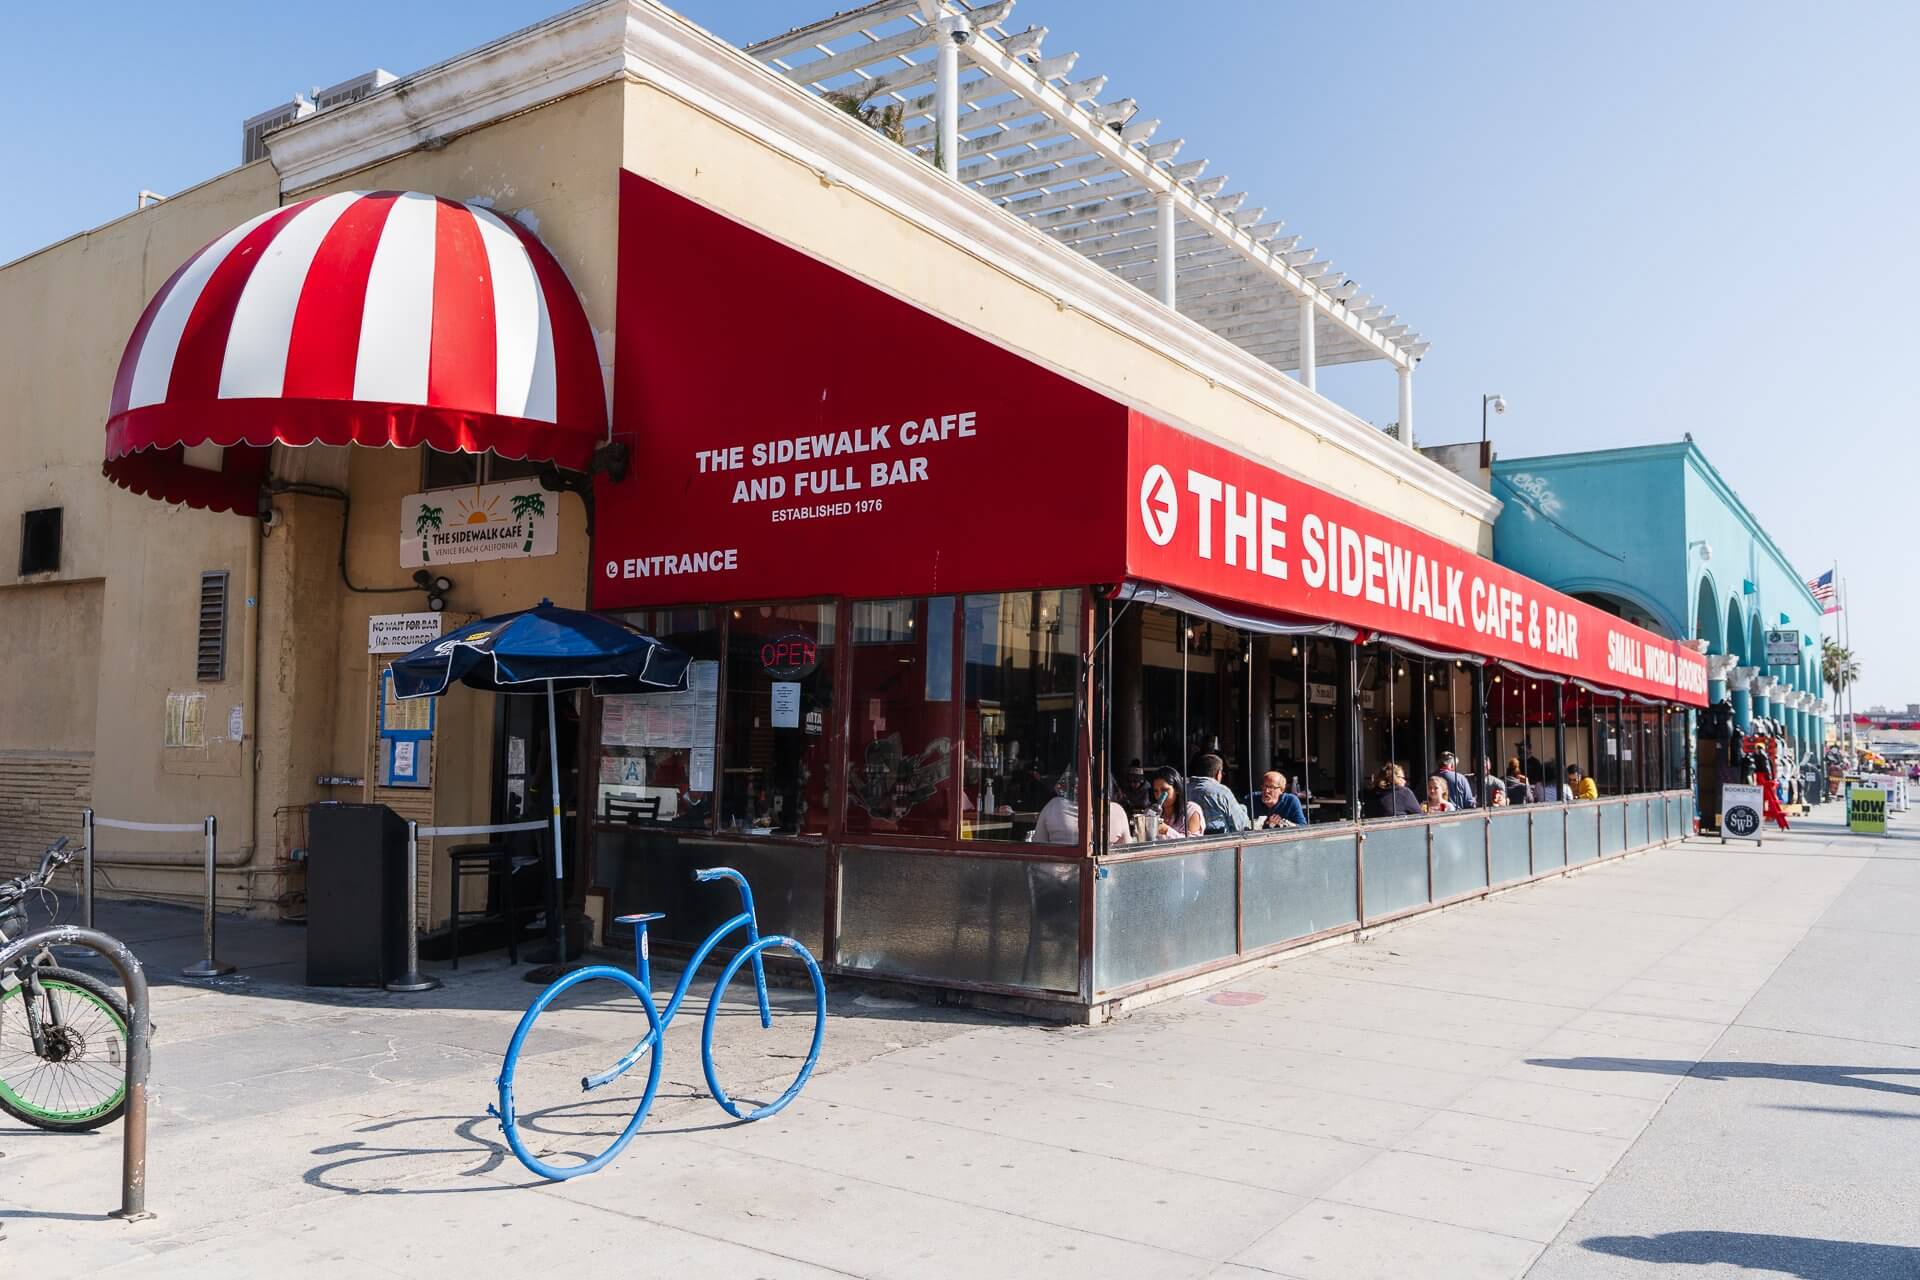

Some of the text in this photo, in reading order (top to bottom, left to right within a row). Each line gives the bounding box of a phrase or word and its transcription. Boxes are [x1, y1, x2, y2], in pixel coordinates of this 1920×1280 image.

[696, 412, 977, 473] THE SIDEWALK CAFE
[732, 457, 929, 503] AND FULL BAR
[772, 499, 882, 522] ESTABLISHED 1976
[432, 532, 454, 545] THE
[452, 528, 498, 543] SIDEWALK
[435, 542, 518, 556] VENICE BEACH CALIFORNIA
[623, 549, 738, 579] ENTRANCE
[1187, 468, 1579, 660] THE SIDEWALK CAFE & BAR
[373, 622, 384, 632] NO
[405, 620, 421, 631] FOR
[422, 619, 438, 630] BAR
[761, 643, 817, 667] OPEN
[1608, 629, 1703, 696] SMALL WORLD BOOKS
[625, 760, 639, 780] A
[1851, 799, 1885, 812] NOW
[1851, 812, 1885, 823] HIRING
